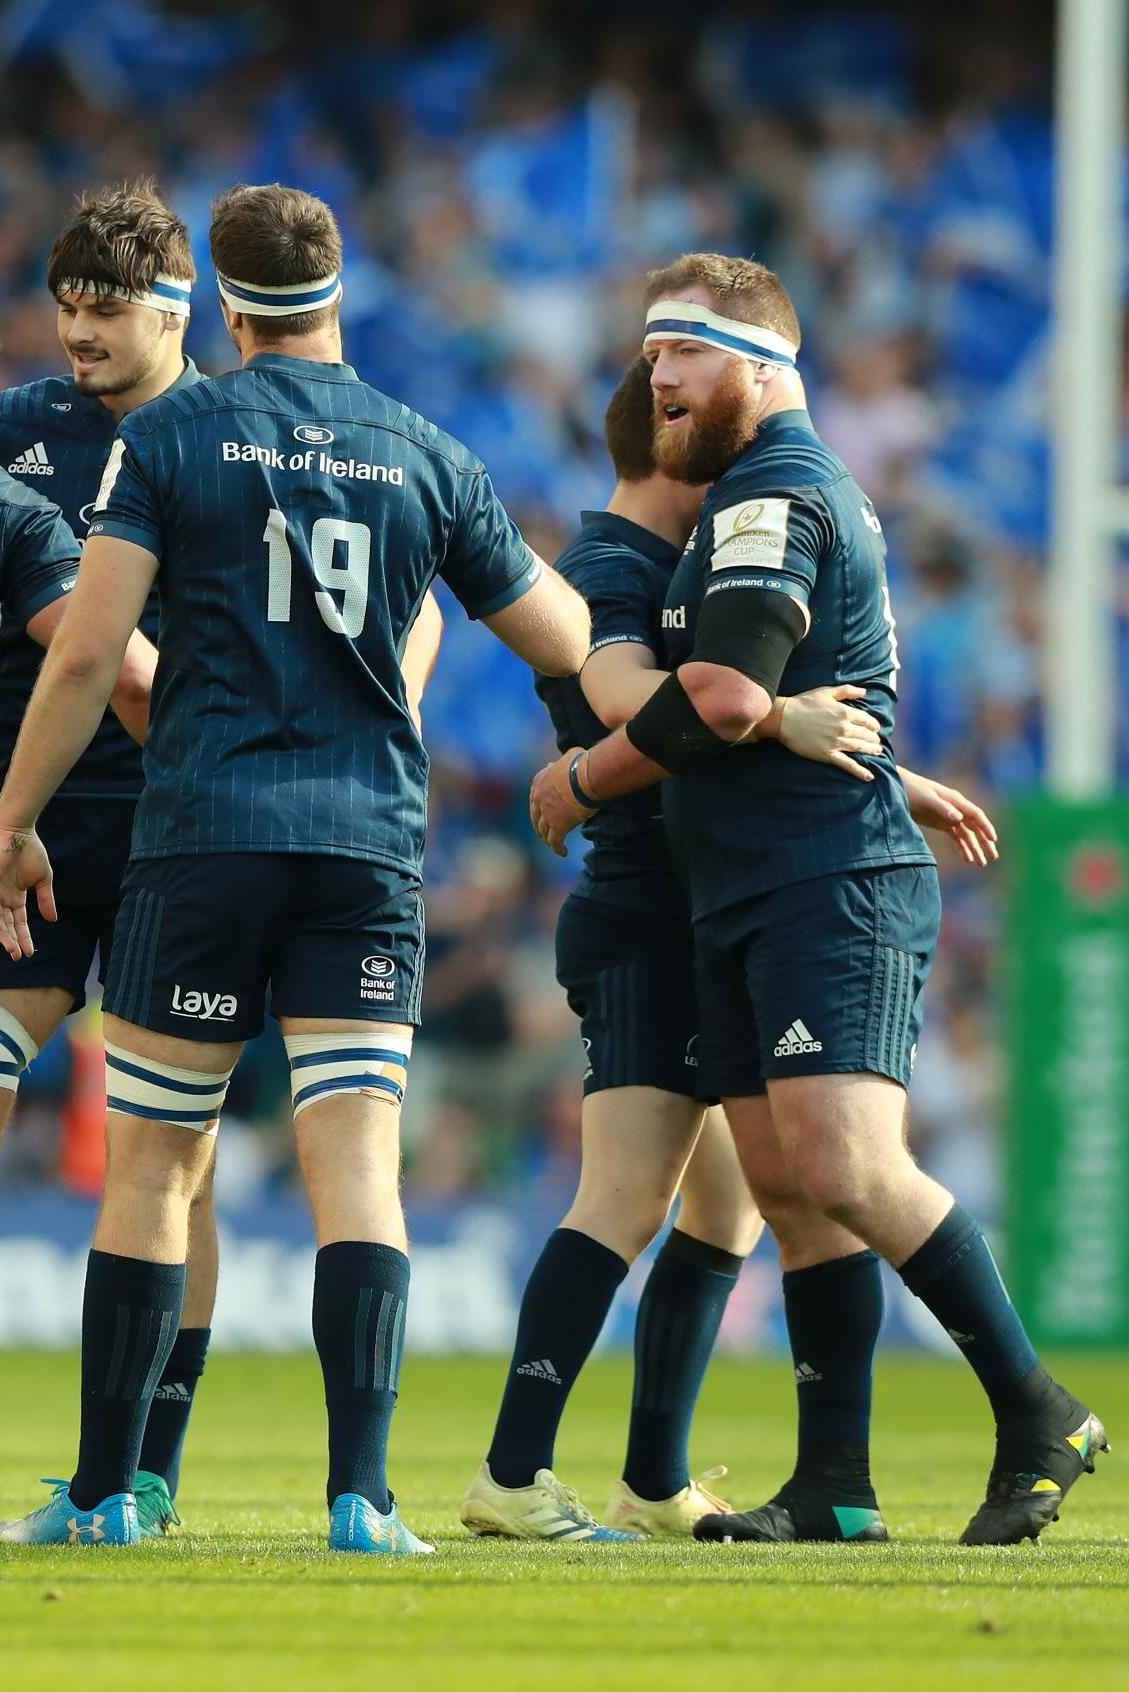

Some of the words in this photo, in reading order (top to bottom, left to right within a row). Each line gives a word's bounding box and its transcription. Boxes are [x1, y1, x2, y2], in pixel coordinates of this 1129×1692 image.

[7, 462, 55, 476] adidas
[222, 442, 285, 471] Bank
[289, 450, 316, 471] of
[319, 452, 404, 487] Ireland
[263, 508, 371, 639] 19
[731, 579, 764, 587] Ireland
[361, 977, 386, 989] Bank
[386, 980, 396, 990] of
[172, 984, 238, 1020] laya
[360, 988, 395, 1001] Ireland
[773, 1041, 823, 1057] adidas
[516, 1367, 563, 1385] adidas
